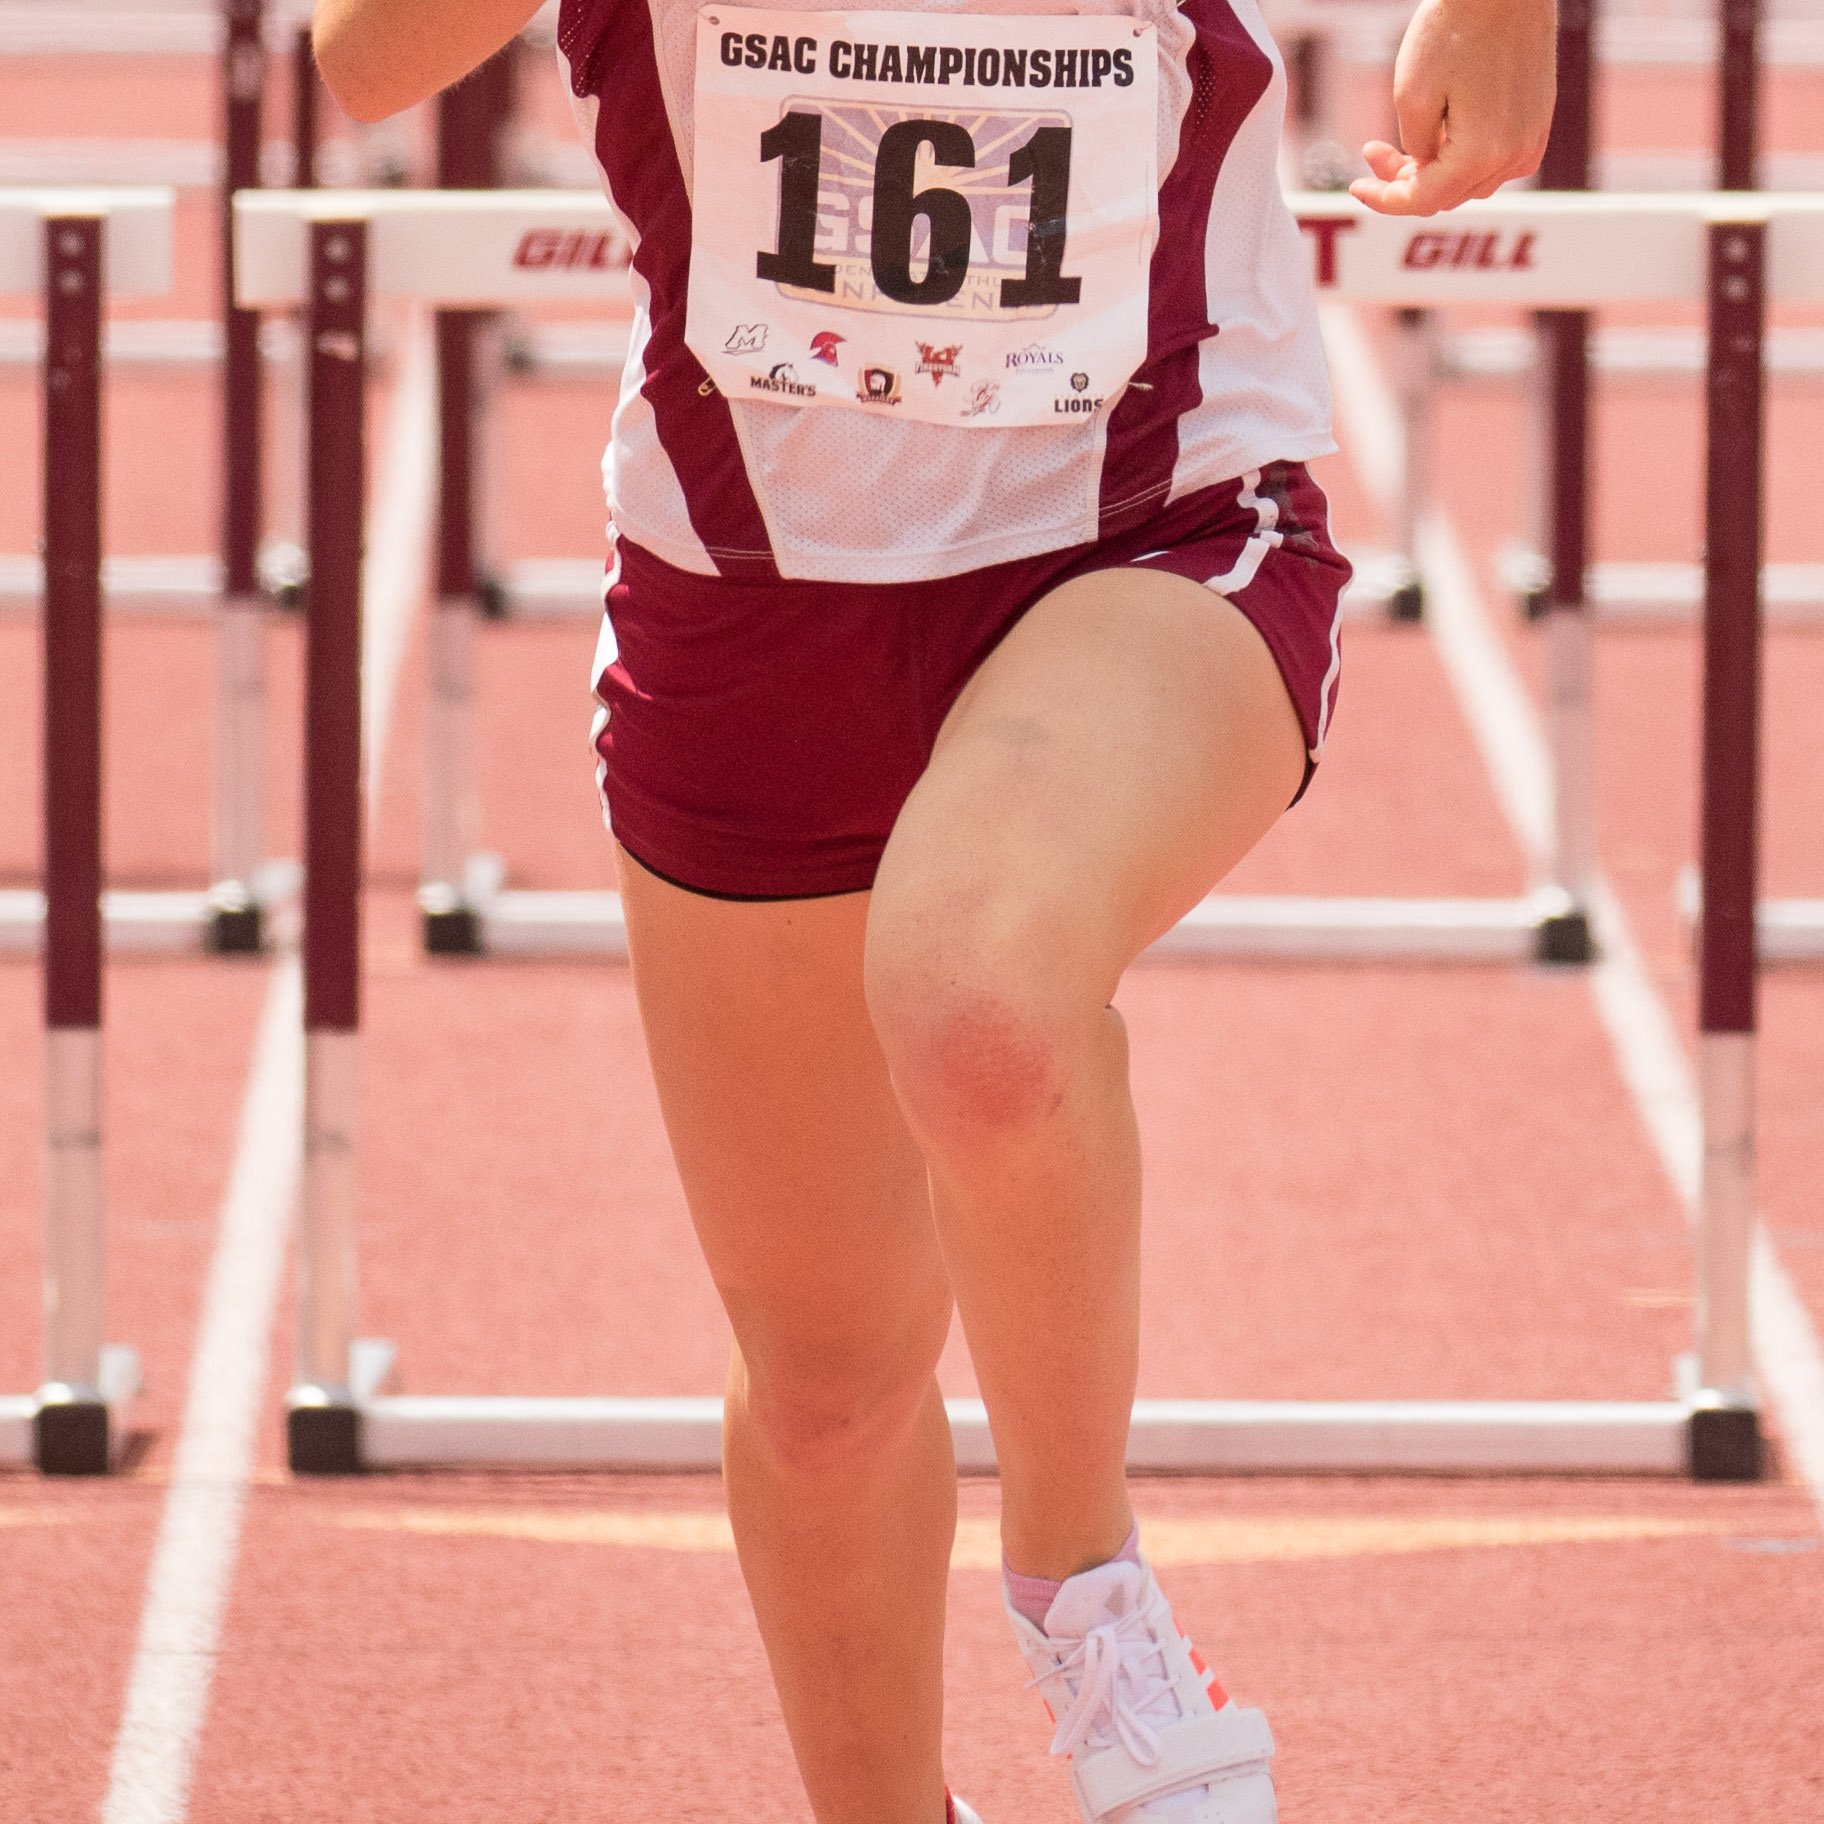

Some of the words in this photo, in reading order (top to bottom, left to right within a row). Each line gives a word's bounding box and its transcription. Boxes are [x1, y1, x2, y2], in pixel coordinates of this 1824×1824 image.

[720, 31, 817, 75] GSAC
[829, 40, 1135, 88] CHAMPIONSHIPS
[755, 110, 1082, 308] 161
[1399, 229, 1538, 272] GILL
[1005, 351, 1064, 369] ROYALS
[749, 376, 817, 397] MASTER'S
